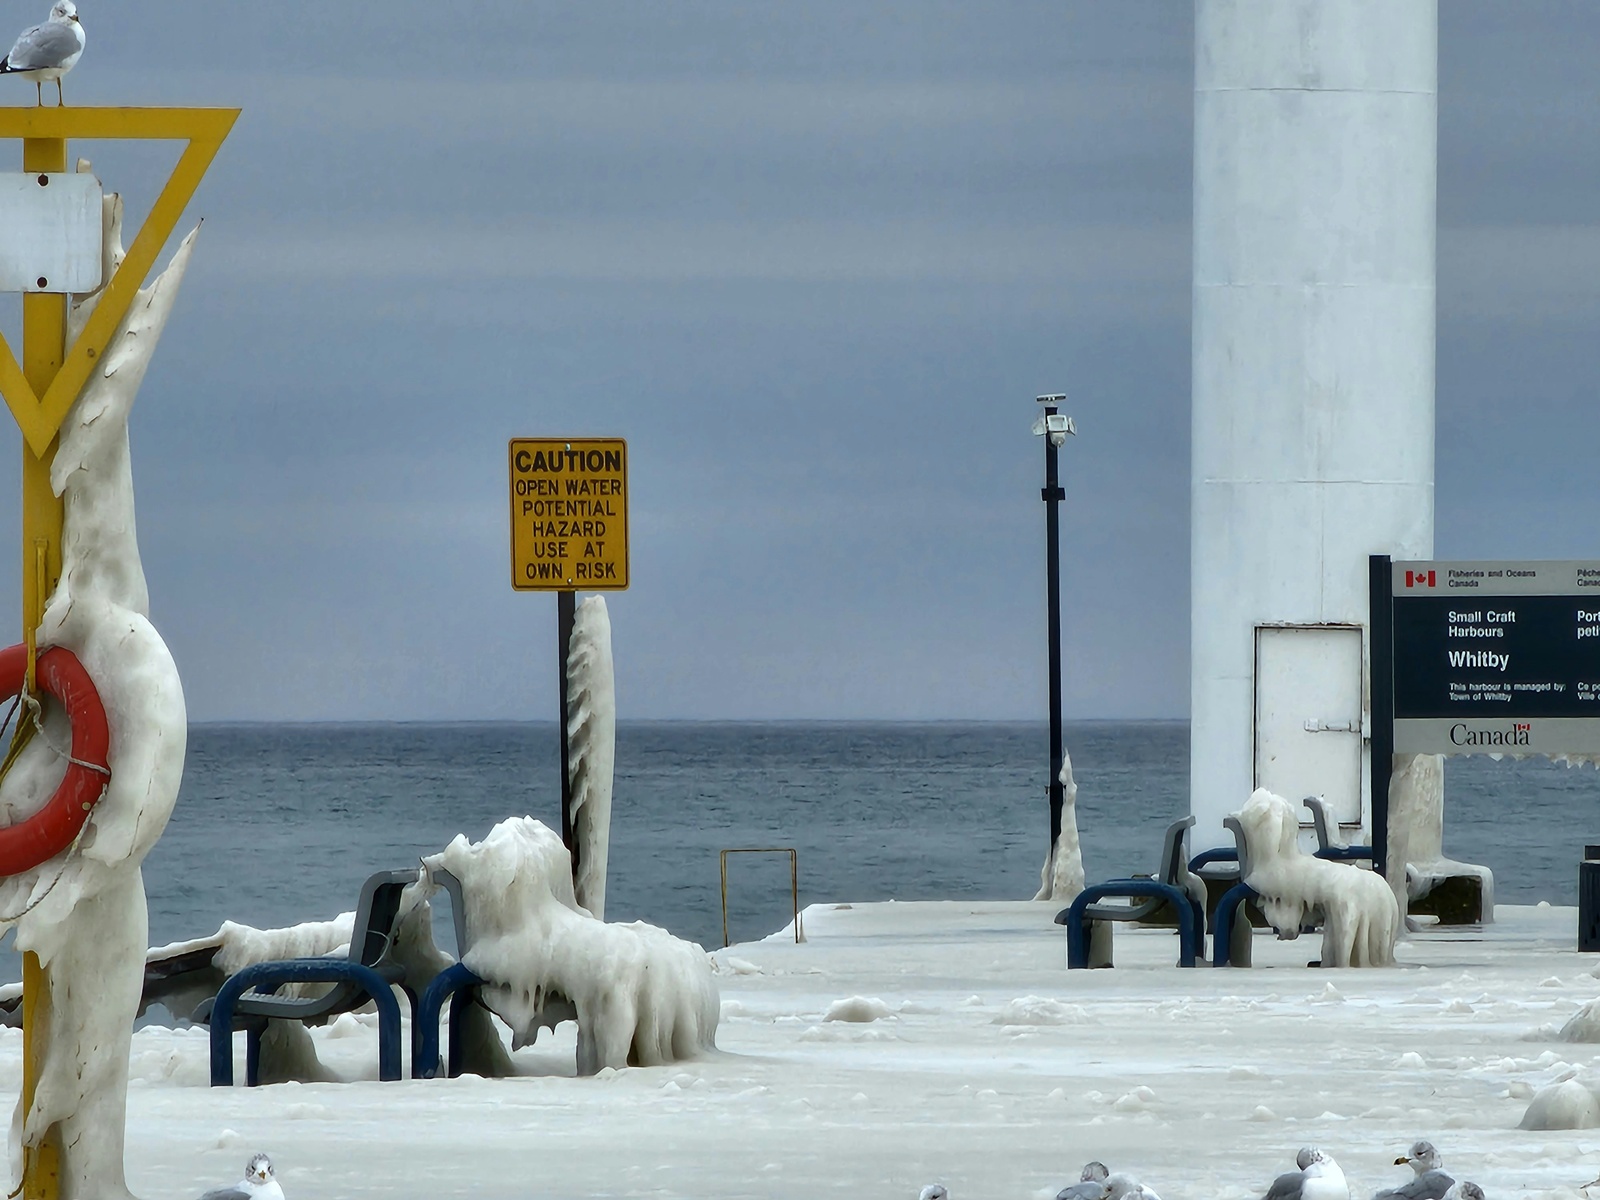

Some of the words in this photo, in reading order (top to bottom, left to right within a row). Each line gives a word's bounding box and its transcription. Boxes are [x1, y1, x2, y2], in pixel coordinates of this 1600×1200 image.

[515, 450, 621, 473] CAUTION
[516, 479, 559, 496] OPEN
[565, 479, 622, 496] WATER
[523, 500, 616, 517] POTENTIAL
[533, 521, 606, 537] HAZARD
[534, 541, 568, 558] USE
[584, 541, 605, 558] AT
[526, 562, 563, 579] OWN
[576, 562, 616, 579] RISK
[1448, 569, 1484, 578] Fisheries
[1488, 569, 1503, 578] and
[1506, 569, 1536, 578] Oceans
[1448, 579, 1479, 588] Canada
[1448, 610, 1482, 623] Small
[1487, 610, 1516, 623] Craft
[1448, 625, 1504, 638] Harbours
[1448, 650, 1510, 671] Whitby
[1449, 682, 1466, 691] This
[1469, 682, 1501, 691] harbour
[1503, 682, 1511, 691] is
[1513, 682, 1551, 692] managed
[1577, 681, 1589, 691] Ce
[1449, 692, 1470, 701] Town
[1472, 692, 1482, 701] of
[1483, 692, 1512, 702] Whitby
[1577, 691, 1595, 701] Ville
[1449, 723, 1530, 746] Canada
